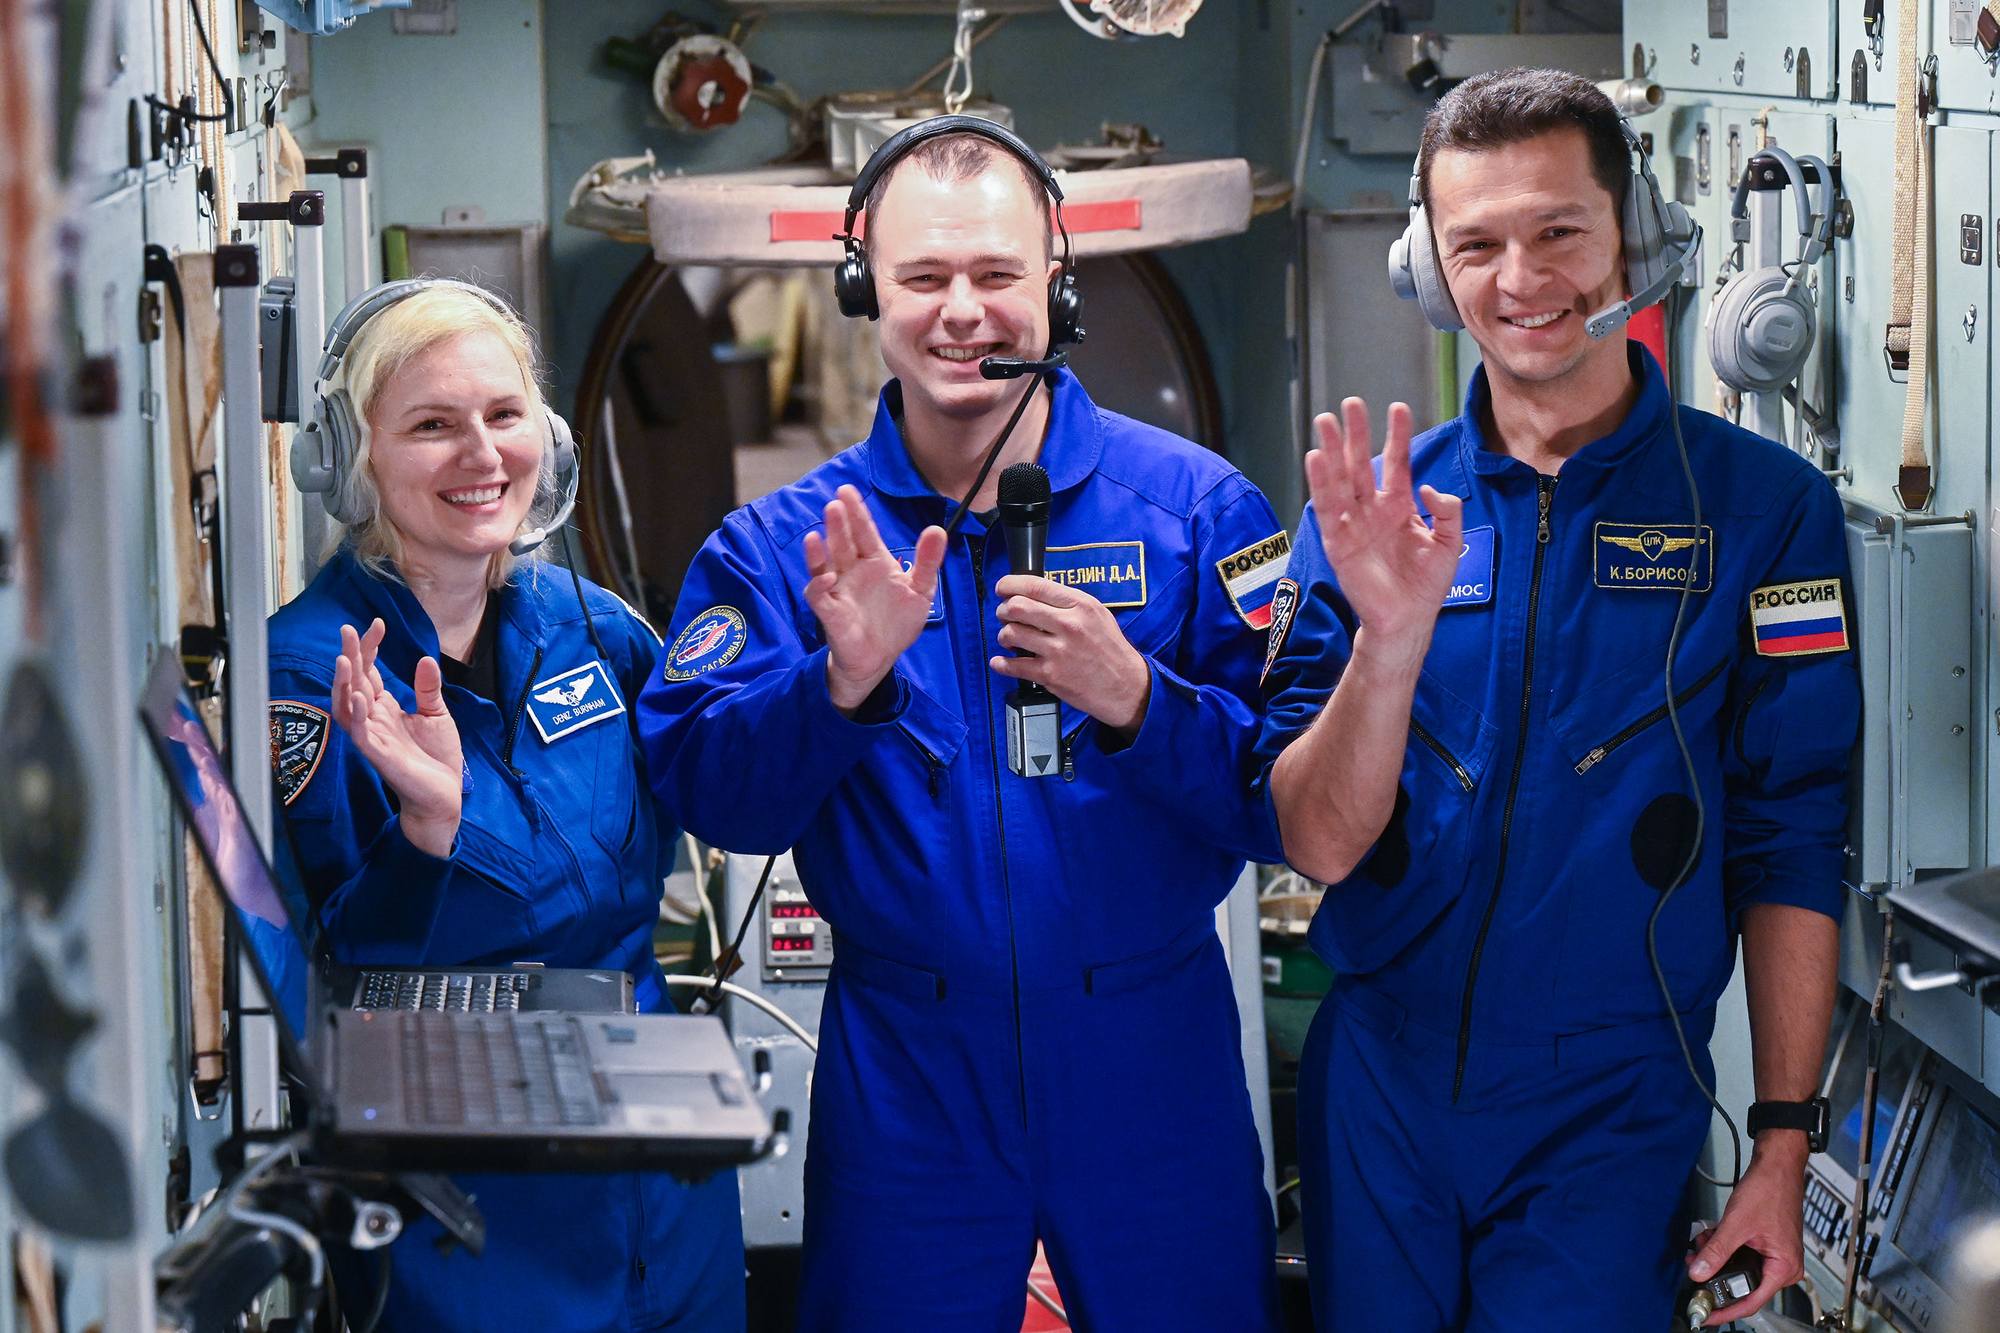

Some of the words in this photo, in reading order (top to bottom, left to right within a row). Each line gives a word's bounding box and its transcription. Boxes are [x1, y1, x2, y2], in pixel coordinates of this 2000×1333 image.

[1643, 536, 1662, 547] ЦПК
[1222, 536, 1290, 580] РОССИЯ
[1109, 565, 1141, 584] Д.А.
[1754, 584, 1837, 609] РОССИЯ
[552, 710, 574, 726] DENIZ
[573, 698, 607, 717] BURNHAM
[286, 722, 307, 735] 29
